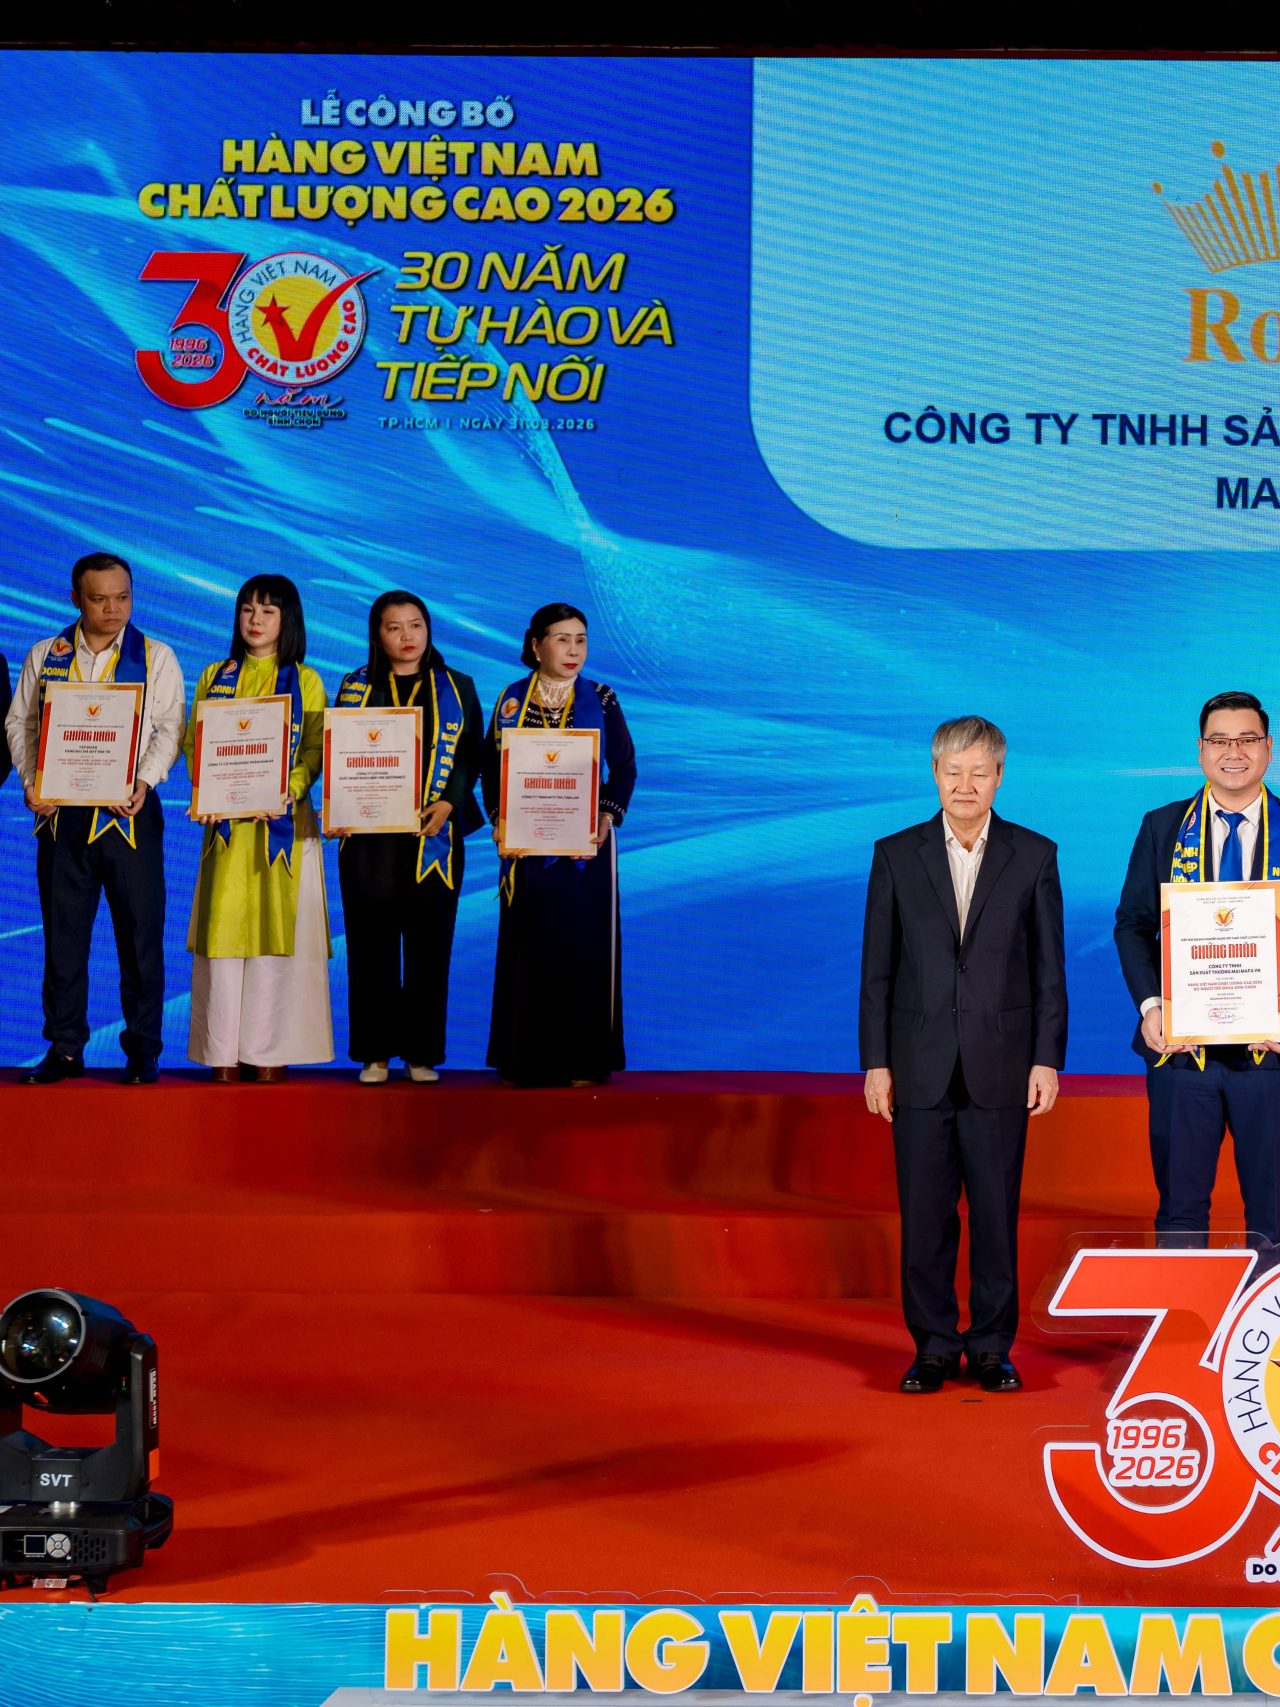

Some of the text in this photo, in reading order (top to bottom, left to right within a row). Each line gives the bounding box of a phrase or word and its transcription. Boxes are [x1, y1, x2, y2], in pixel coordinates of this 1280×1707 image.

[301, 89, 514, 128] LỄ CÔNG BỐ
[222, 132, 599, 182] HÀNG VIỆT NAM
[138, 177, 674, 227] CHẤT LƯỢNG CAO 2026
[294, 259, 337, 287] NAM
[395, 244, 626, 291] 30 NĂM
[342, 300, 356, 334] CAO
[390, 298, 673, 351] TỰ HÀO VÀ
[170, 338, 207, 350] 1996
[171, 353, 214, 367] 2026
[376, 354, 606, 401] TIẾP NỐI
[884, 405, 1011, 444] CÔNG
[1025, 412, 1079, 445] TY
[1092, 413, 1208, 446] TNHH
[1228, 1328, 1270, 1433] HÀNG
[1113, 1425, 1182, 1449] 1996
[39, 1473, 72, 1487] SVT
[1115, 1455, 1195, 1480] 2026
[1252, 1563, 1277, 1576] DO
[384, 1591, 711, 1695] HÀNG
[720, 1594, 953, 1707] VIỆT
[966, 1612, 1233, 1697] NAM
